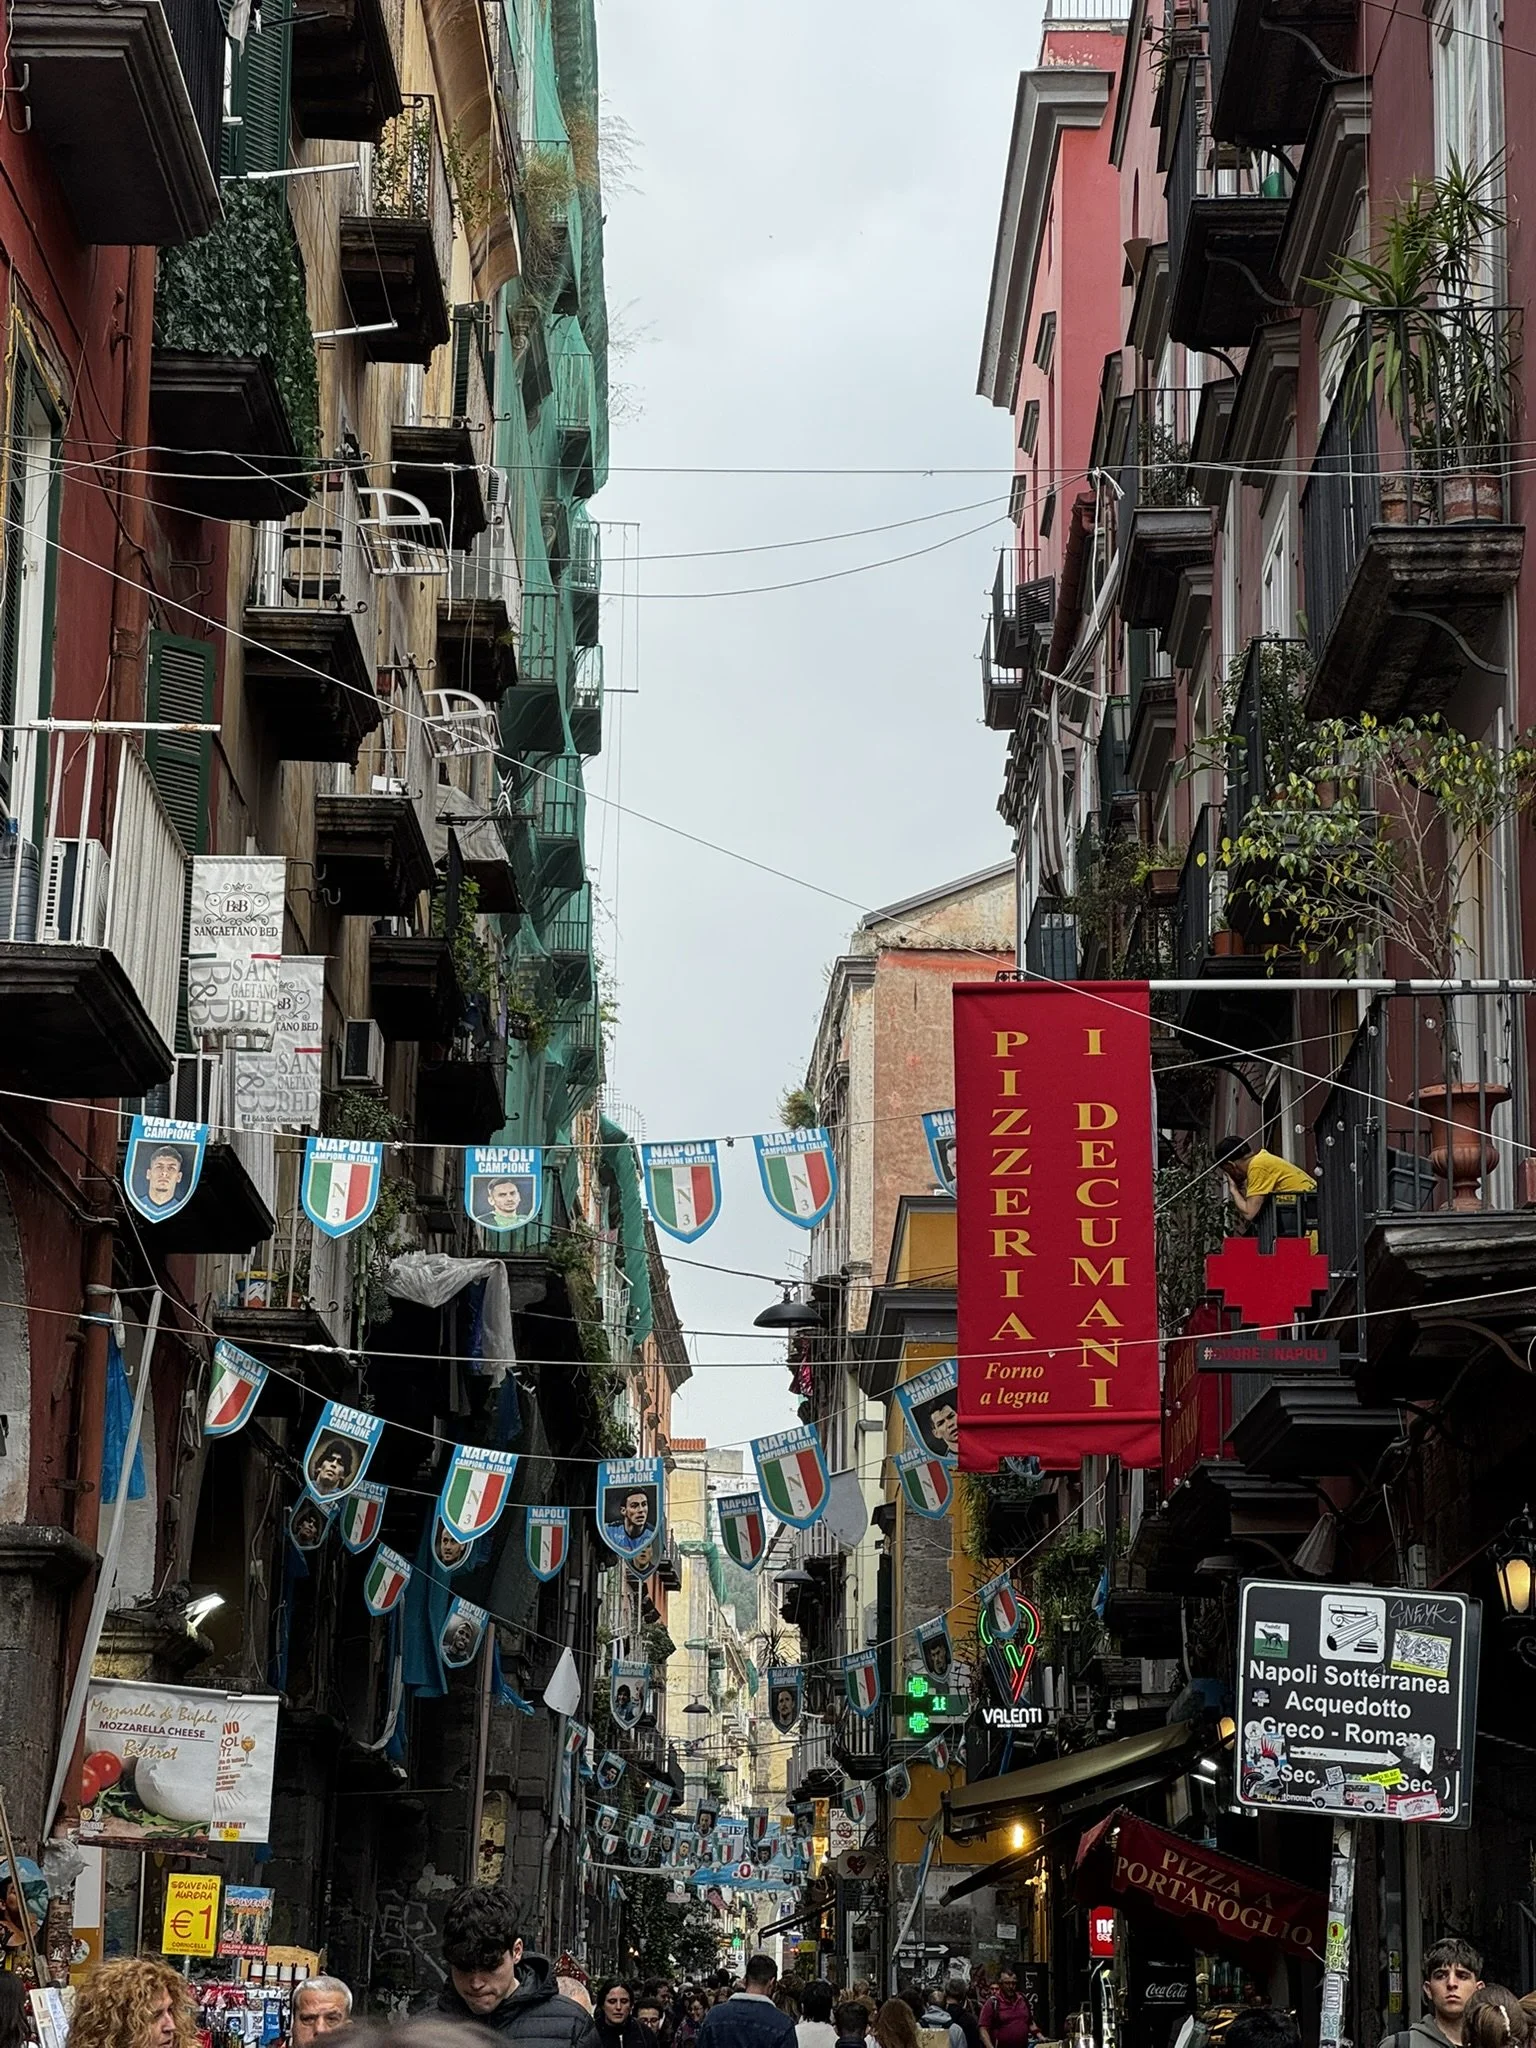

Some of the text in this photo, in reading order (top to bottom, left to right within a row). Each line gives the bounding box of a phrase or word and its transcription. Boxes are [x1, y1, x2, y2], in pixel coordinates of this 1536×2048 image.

[226, 900, 248, 913] B&B
[194, 925, 278, 937] SANGAETANO BED
[231, 959, 279, 982] SAN
[231, 983, 278, 999] GAETANO
[230, 1000, 278, 1023] BED
[301, 1022, 319, 1032] BED
[278, 1052, 320, 1075] SAN
[277, 1090, 320, 1113] BED
[144, 1127, 196, 1141] CAMPIONE
[762, 1128, 822, 1148] NAPOLI
[315, 1138, 375, 1155] NAPOLI
[474, 1147, 534, 1163] NAPOLI
[650, 1142, 709, 1158] NAPOLI
[760, 1144, 797, 1157] CAMPIONE
[805, 1139, 828, 1150] ITALIA
[310, 1152, 379, 1164] CAMPIONE IN ITALIA
[478, 1161, 531, 1174] CAMPIONE
[647, 1154, 716, 1166] CAMPIONE IN ITALIA
[988, 1030, 1037, 1341] PIZZERIA
[1069, 1028, 1130, 1408] I DECUMANI
[220, 1344, 264, 1376] NAPOLI
[904, 1361, 956, 1397] NAPOLI
[984, 1361, 1045, 1381] Forno
[911, 1376, 957, 1405] CAMPIONE
[980, 1386, 1050, 1407] a legna
[330, 1403, 379, 1431] NAPOLI
[329, 1417, 372, 1439] CAMPIONE
[757, 1423, 811, 1454] NAPOLI
[460, 1446, 513, 1466] NAPOLI
[757, 1448, 789, 1463] CAMPIONE
[796, 1437, 818, 1452] ITALIA
[455, 1458, 513, 1474] CAMPIONE IN ITALIA
[606, 1458, 657, 1474] NAPOLI
[609, 1471, 654, 1484] CAMPIONE
[354, 1481, 385, 1496] APOLI
[531, 1507, 565, 1519] NAPOLI
[721, 1496, 757, 1510] NAPOLI
[382, 1546, 411, 1572] NAPOLI
[458, 1598, 487, 1620] NAPOLI
[1250, 1660, 1317, 1686] Napoli
[1324, 1665, 1450, 1694] Sotterranea
[90, 1699, 157, 1719] Mozzarella
[178, 1706, 218, 1727] Bufala
[1285, 1691, 1411, 1719] Acquedotto
[982, 1707, 1042, 1725] VALENTI
[99, 1721, 206, 1739] MOZZARELLA CHEESE
[1261, 1716, 1325, 1741] Greco
[122, 1738, 179, 1760] Bistrot
[1280, 1765, 1321, 1785] Sec.
[1397, 1773, 1438, 1793] Sec.
[212, 1821, 247, 1830] TAKE AWAY
[1160, 1849, 1273, 1910] PIZZA A
[175, 1890, 212, 1900] AURORA
[1115, 1855, 1313, 1945] PORTAFOGLIO
[171, 1941, 207, 1949] CORNICELLI
